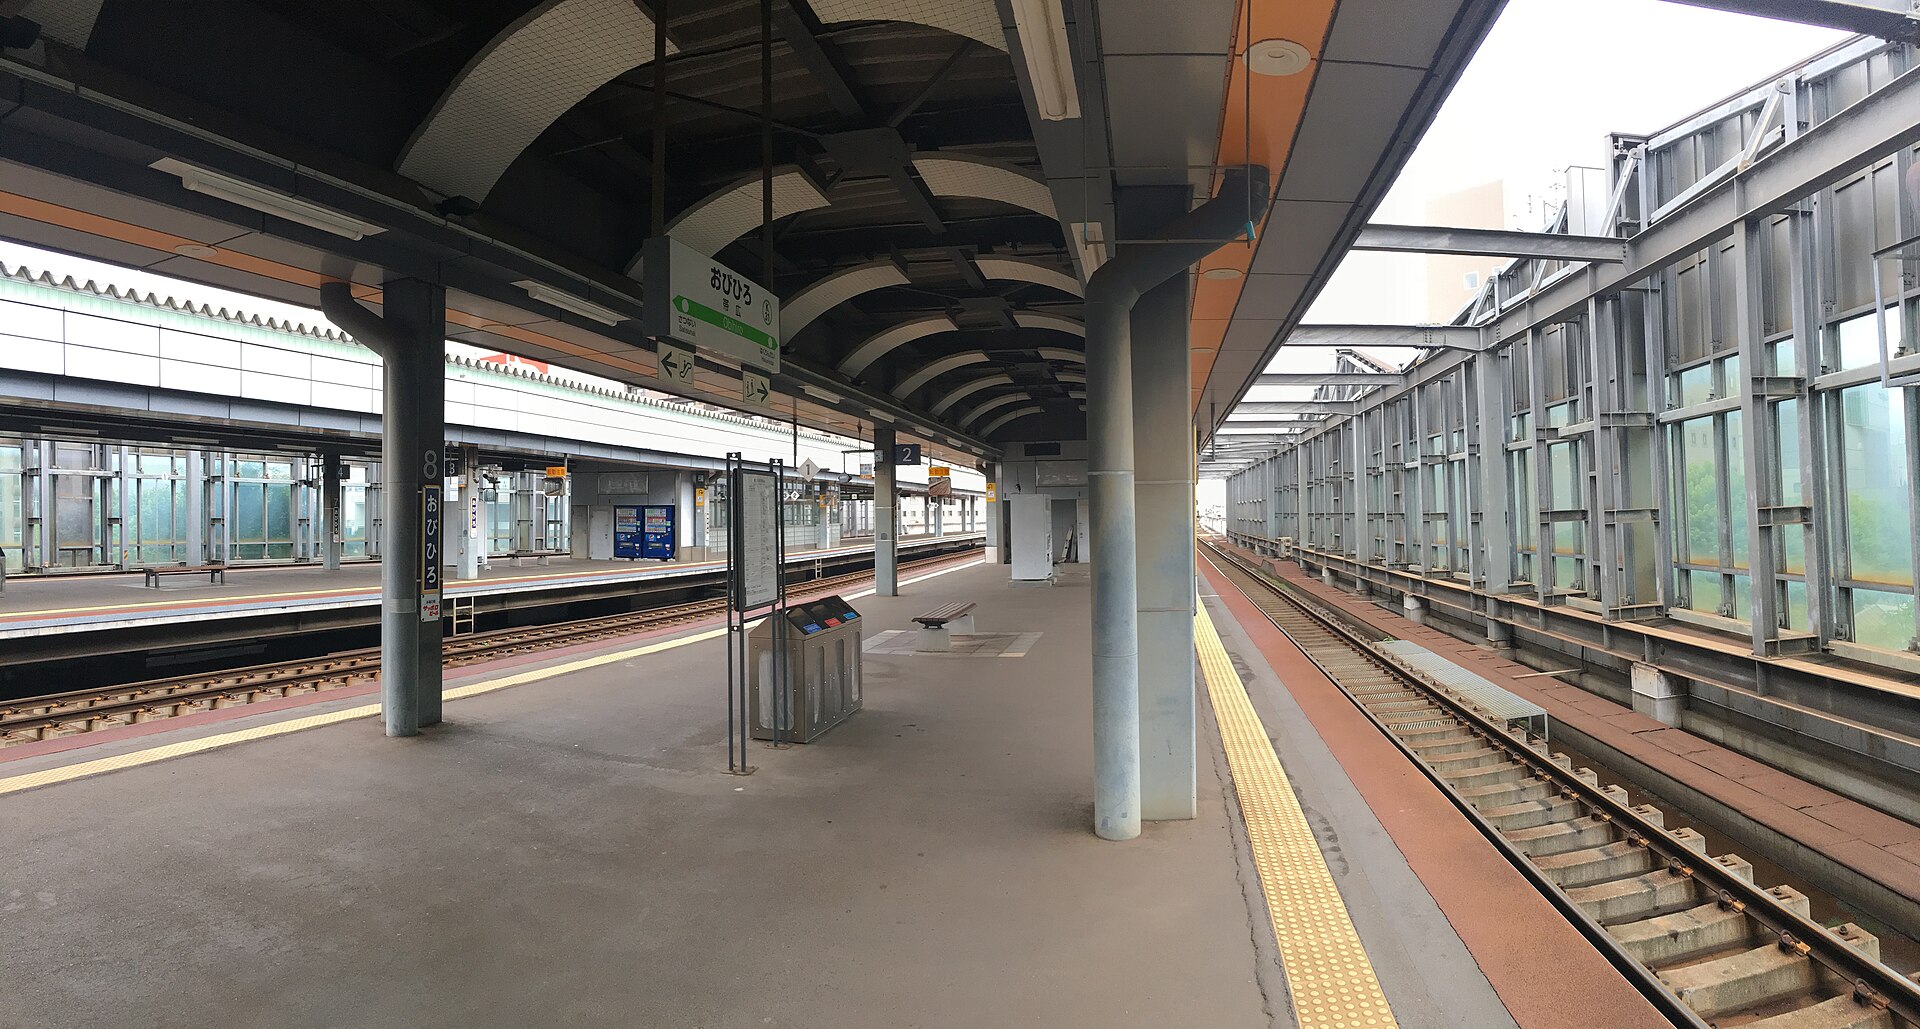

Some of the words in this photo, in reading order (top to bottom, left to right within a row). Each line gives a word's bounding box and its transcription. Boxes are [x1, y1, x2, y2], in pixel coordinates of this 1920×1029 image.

[711, 266, 752, 305] おびひろ
[424, 450, 438, 480] 8
[902, 447, 912, 462] 2
[806, 464, 810, 476] 1
[792, 491, 797, 499] 2
[427, 495, 438, 583] おびひろ
